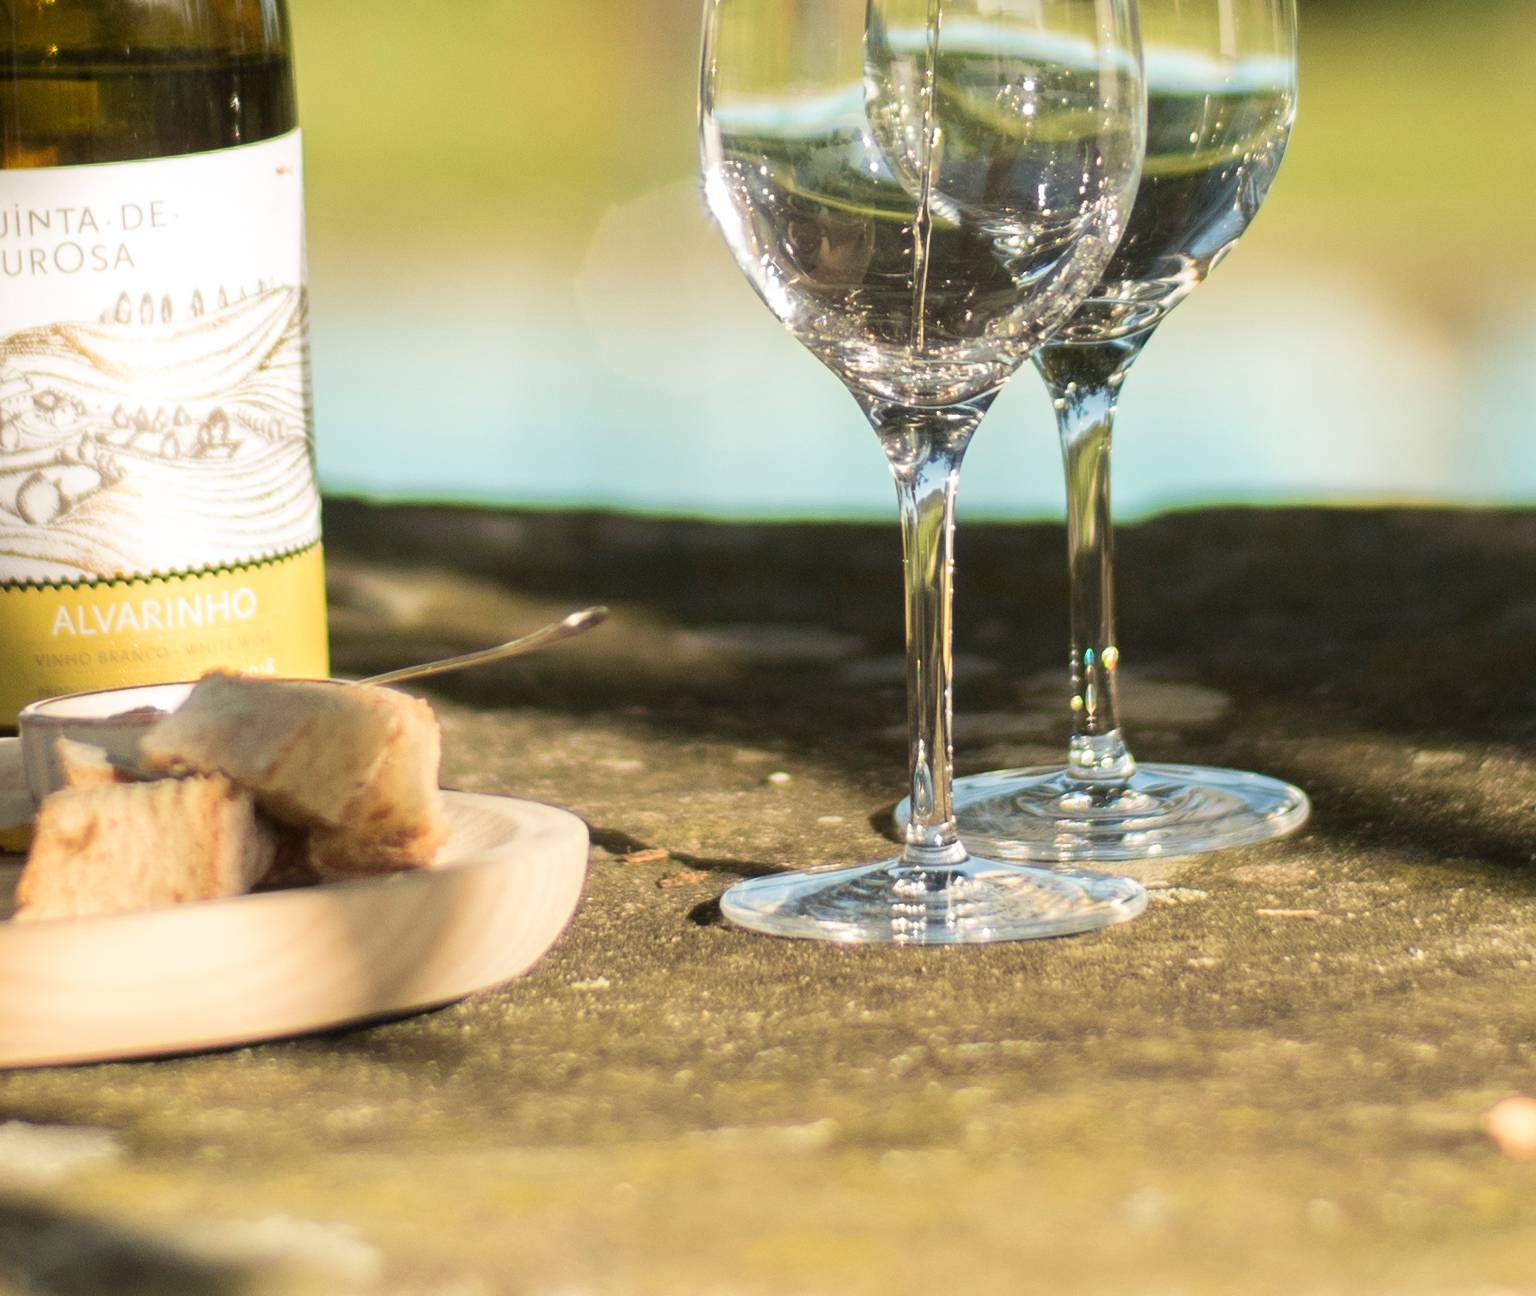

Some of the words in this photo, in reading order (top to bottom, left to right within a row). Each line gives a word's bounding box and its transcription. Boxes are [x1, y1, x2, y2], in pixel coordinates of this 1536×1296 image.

[120, 199, 167, 231] DE
[50, 586, 258, 638] ALVARINHO
[34, 650, 92, 669] VINHO
[97, 645, 170, 666] BRANCO
